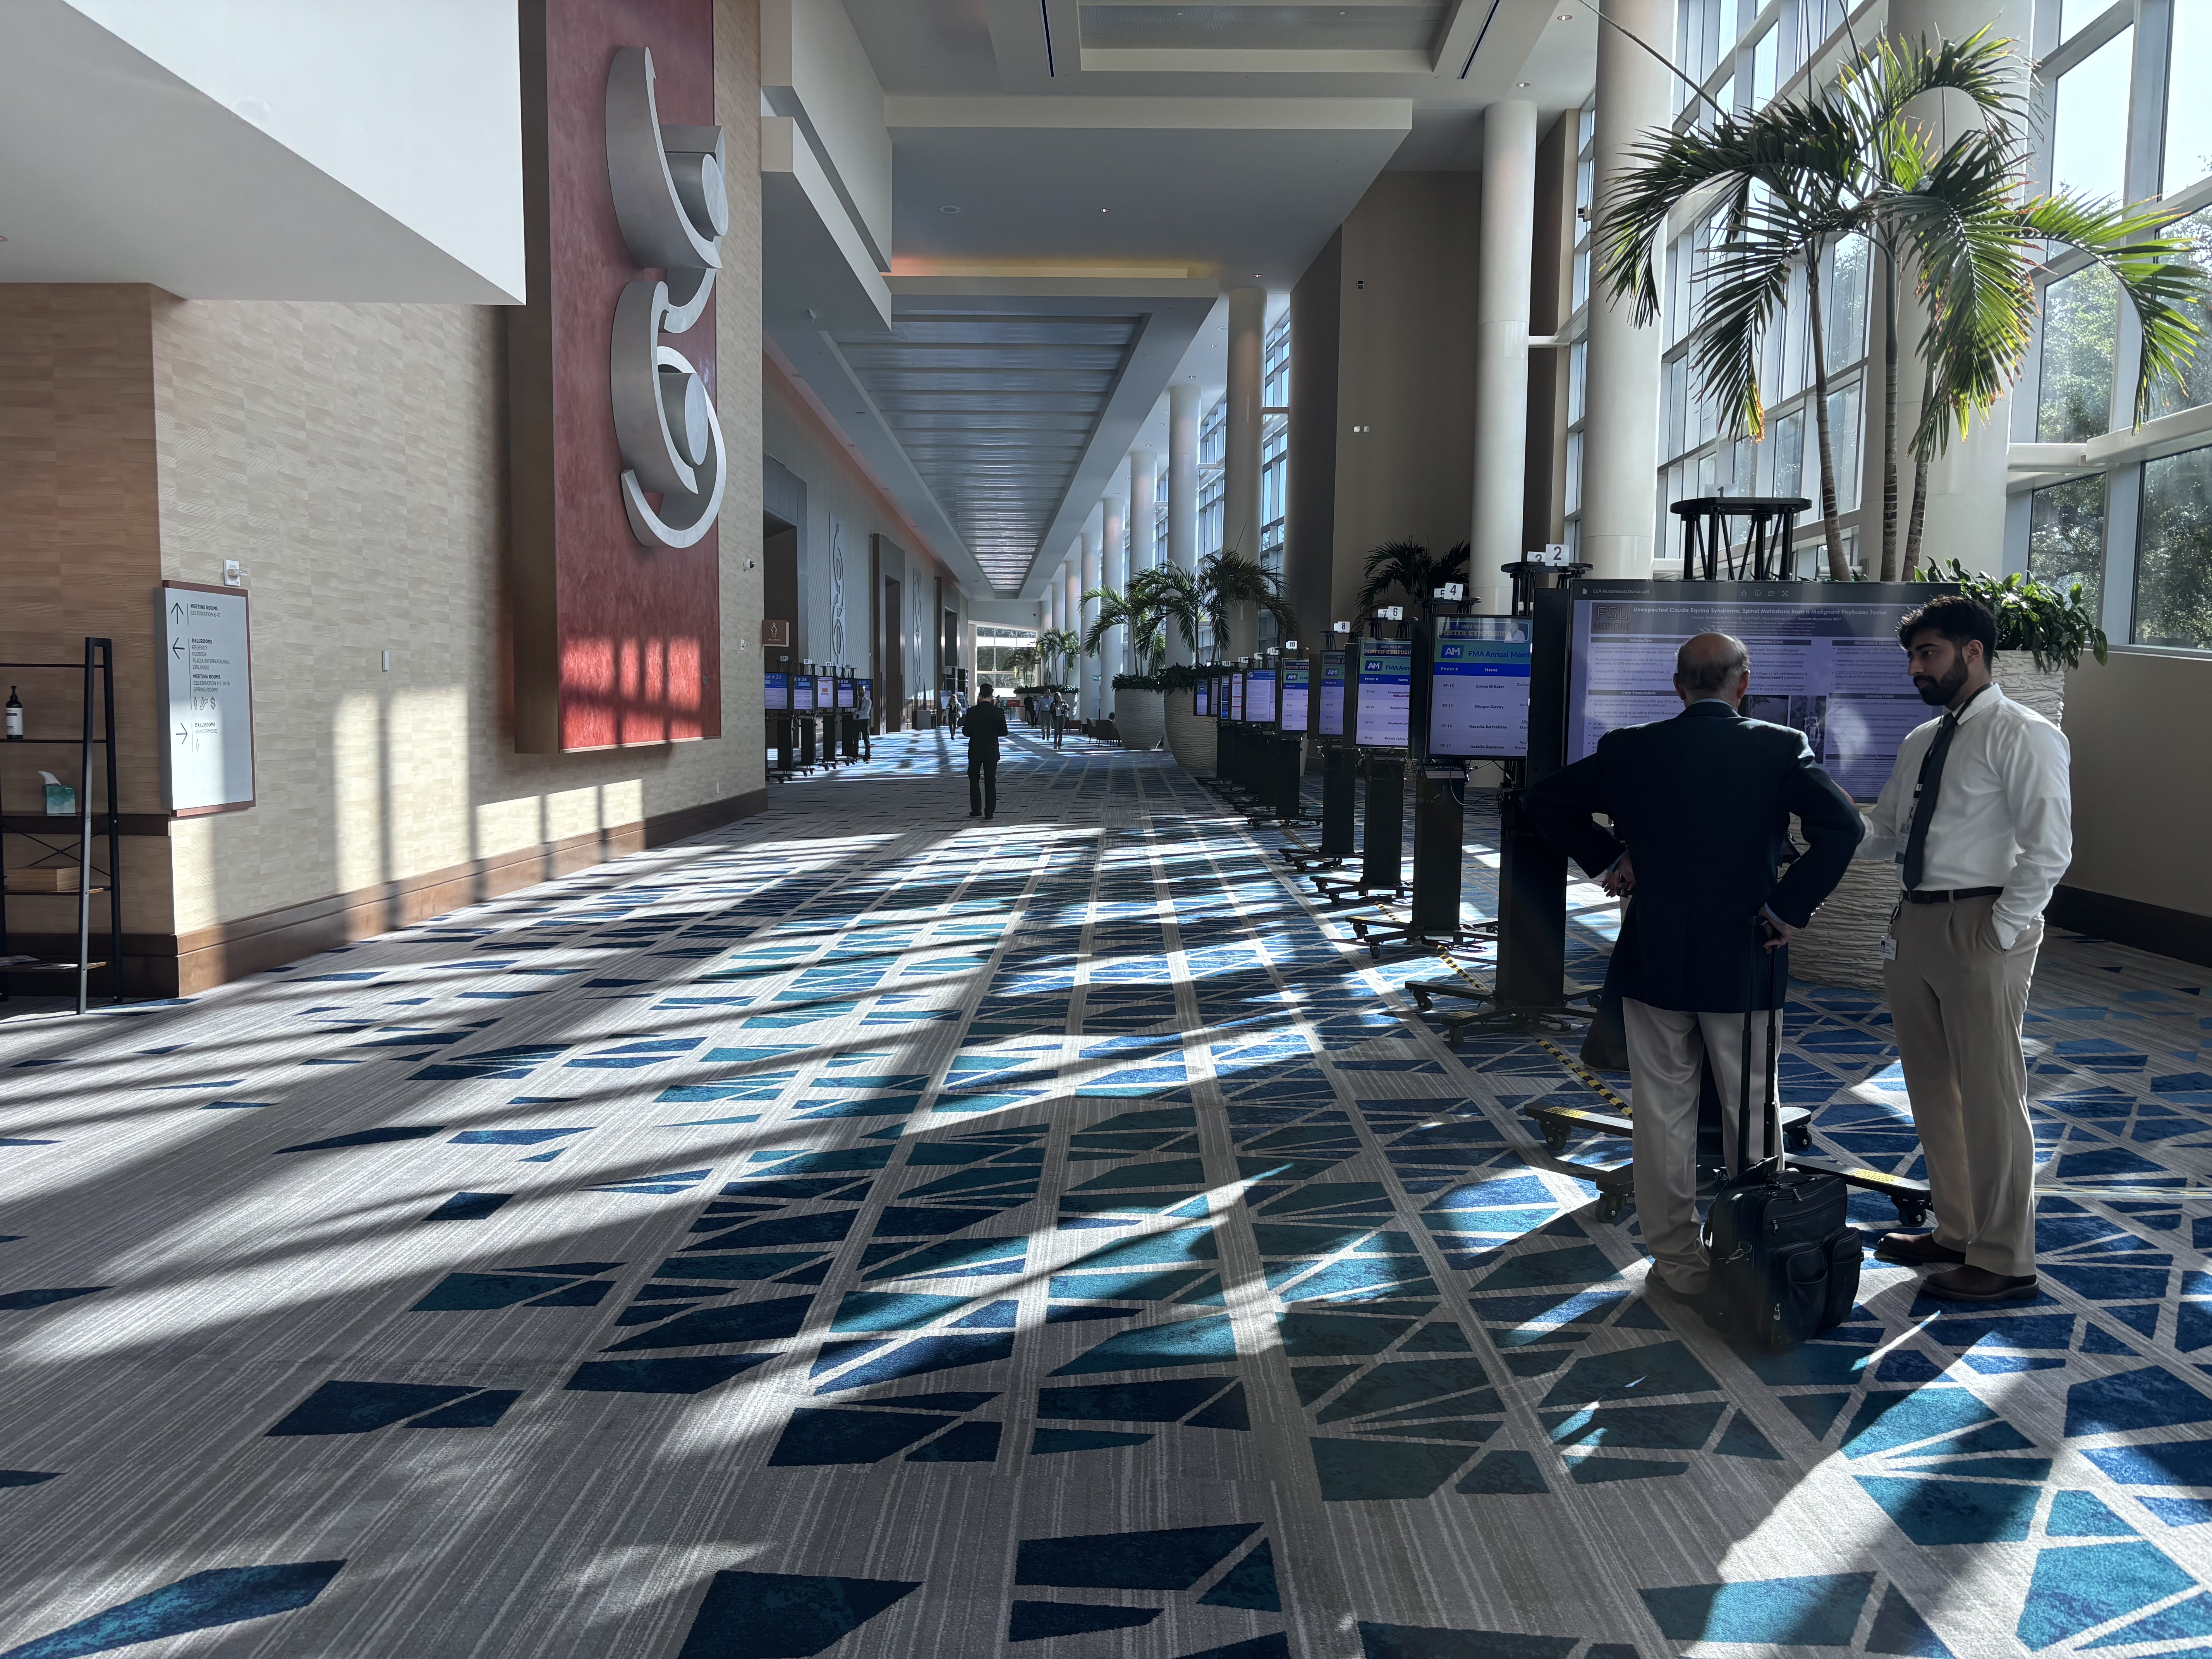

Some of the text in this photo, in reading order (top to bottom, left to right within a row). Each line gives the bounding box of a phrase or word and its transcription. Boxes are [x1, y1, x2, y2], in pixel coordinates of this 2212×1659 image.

[1553, 546, 1561, 560] 2
[1450, 585, 1457, 596] 4
[1393, 608, 1398, 617] 6
[1596, 606, 1630, 620] FSU
[1444, 647, 1460, 656] AM
